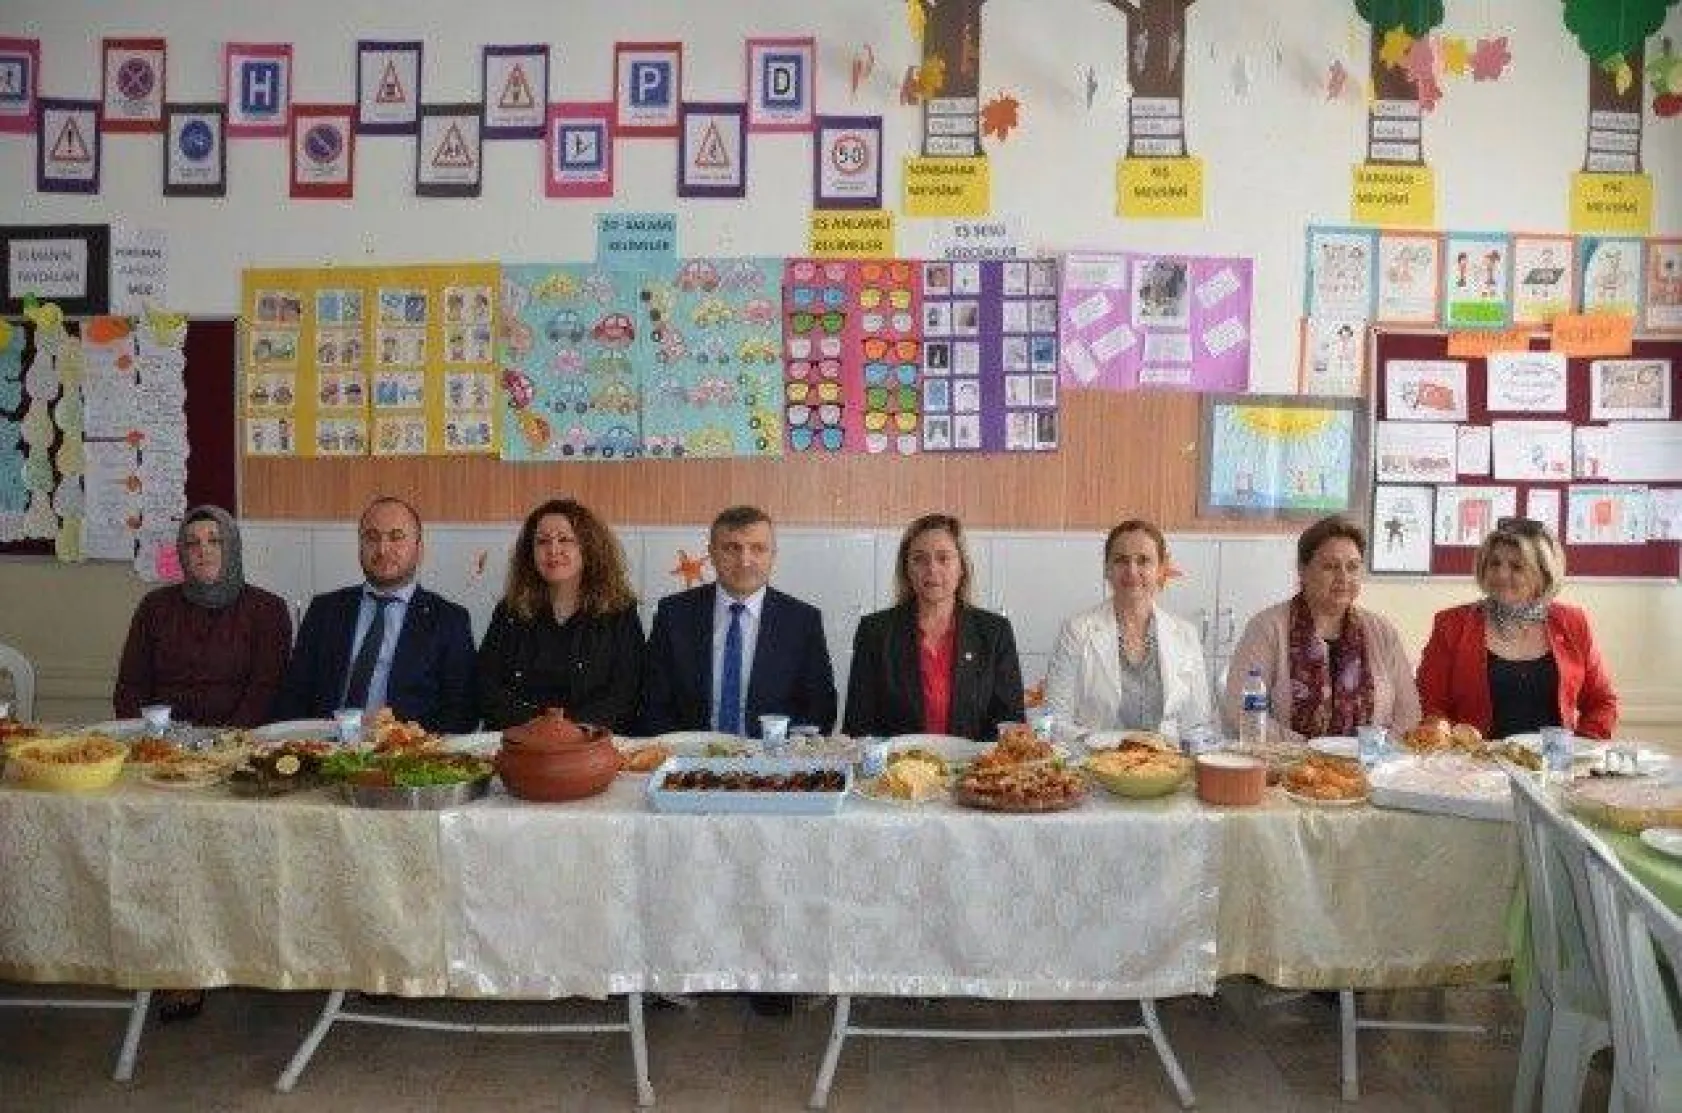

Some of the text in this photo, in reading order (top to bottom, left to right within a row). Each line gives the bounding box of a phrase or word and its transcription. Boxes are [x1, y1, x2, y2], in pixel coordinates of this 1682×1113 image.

[249, 70, 272, 106] H
[639, 66, 661, 101] P
[773, 66, 791, 95] D
